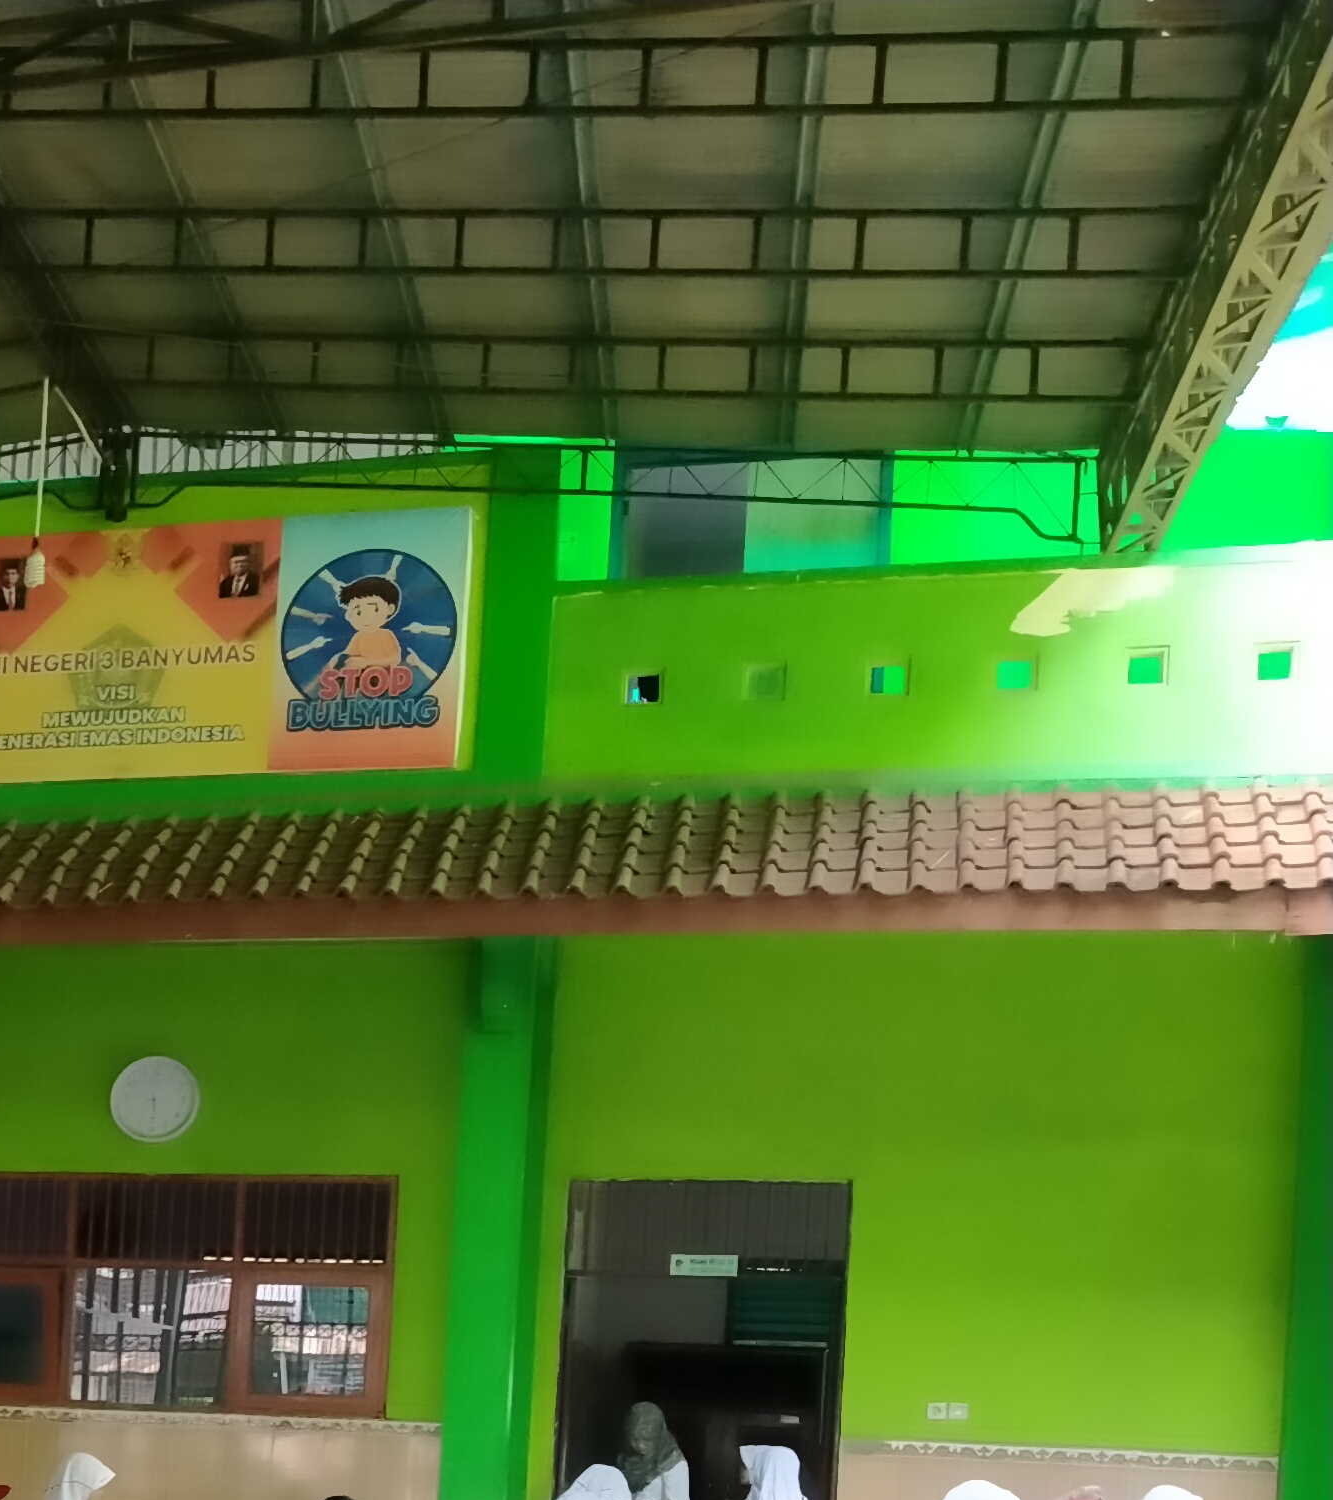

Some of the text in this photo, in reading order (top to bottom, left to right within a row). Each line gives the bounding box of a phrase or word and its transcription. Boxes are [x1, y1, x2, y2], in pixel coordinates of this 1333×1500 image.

[14, 651, 94, 673] NEGERI
[101, 651, 114, 669] 3
[121, 644, 256, 669] BANYUMAS
[96, 684, 136, 700] VISI
[319, 665, 413, 700] STOP
[41, 707, 186, 728] MEWUJUDKAN
[288, 697, 439, 730] BULLYING
[79, 729, 134, 748] EMAS
[135, 725, 244, 745] INDONESIA
